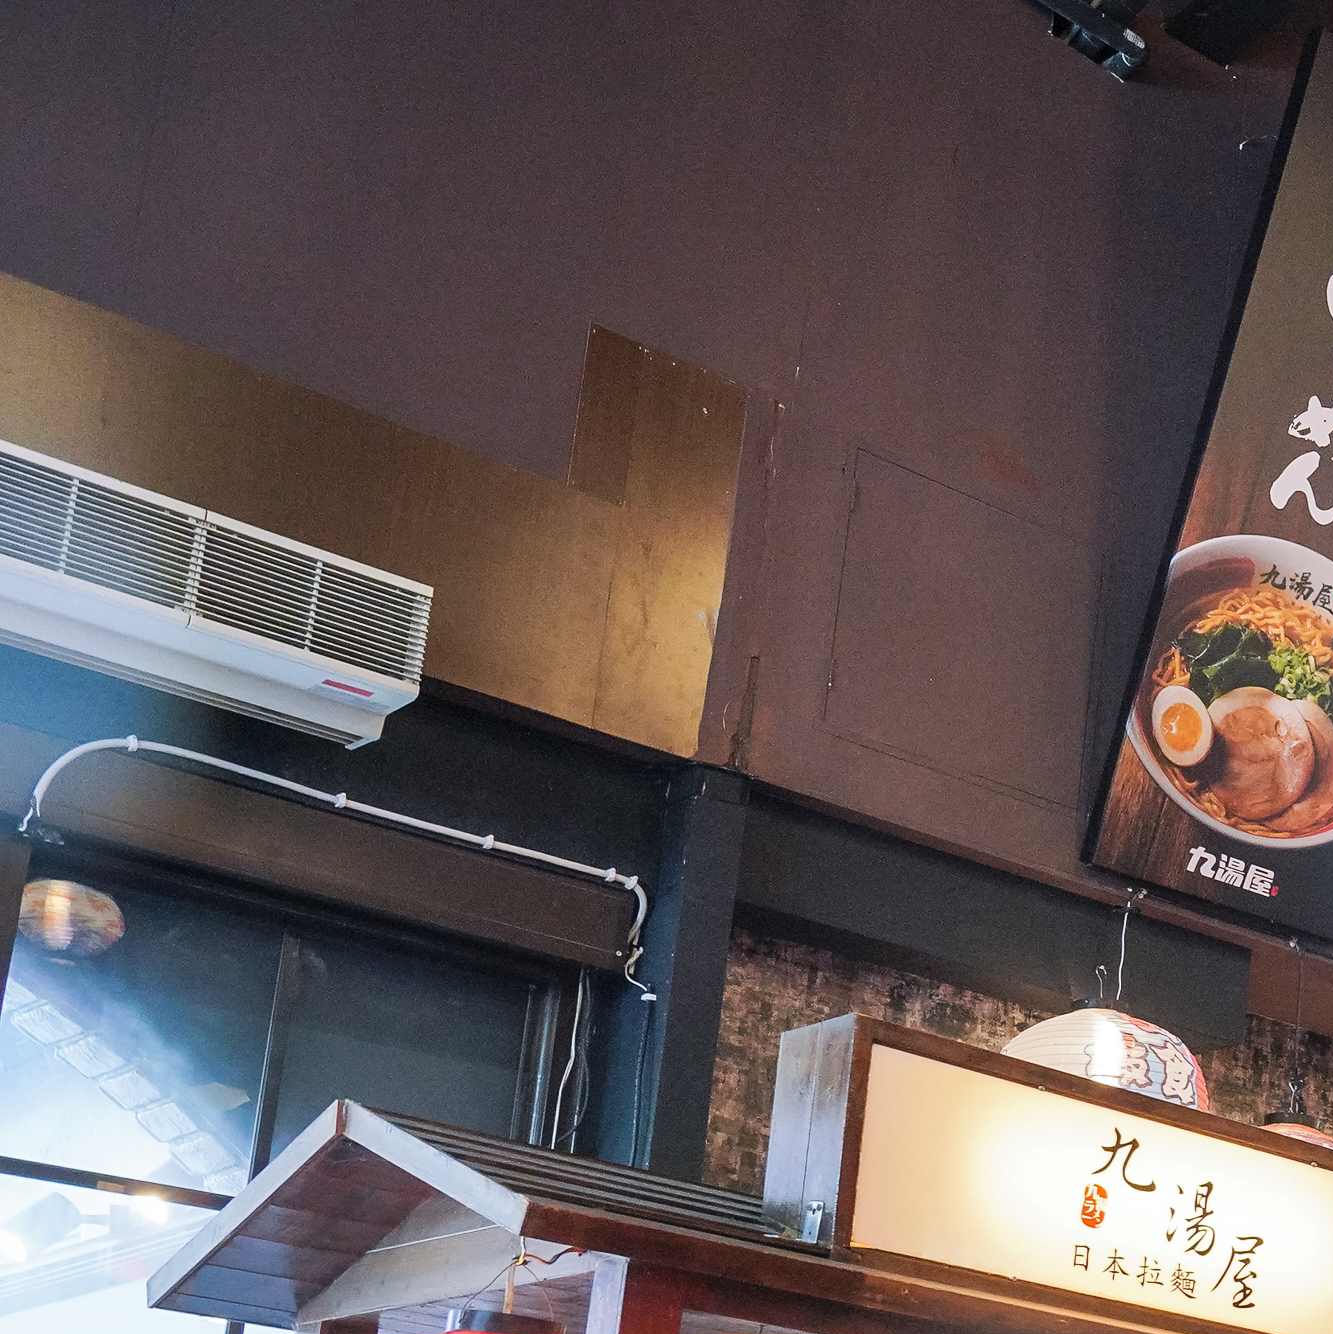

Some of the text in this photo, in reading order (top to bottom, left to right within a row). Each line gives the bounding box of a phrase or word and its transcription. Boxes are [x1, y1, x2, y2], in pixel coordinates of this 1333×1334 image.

[1187, 846, 1275, 897] 九湯屋
[1091, 1127, 1264, 1308] 九湯屋
[1073, 1245, 1198, 1299] 日本拉麵
